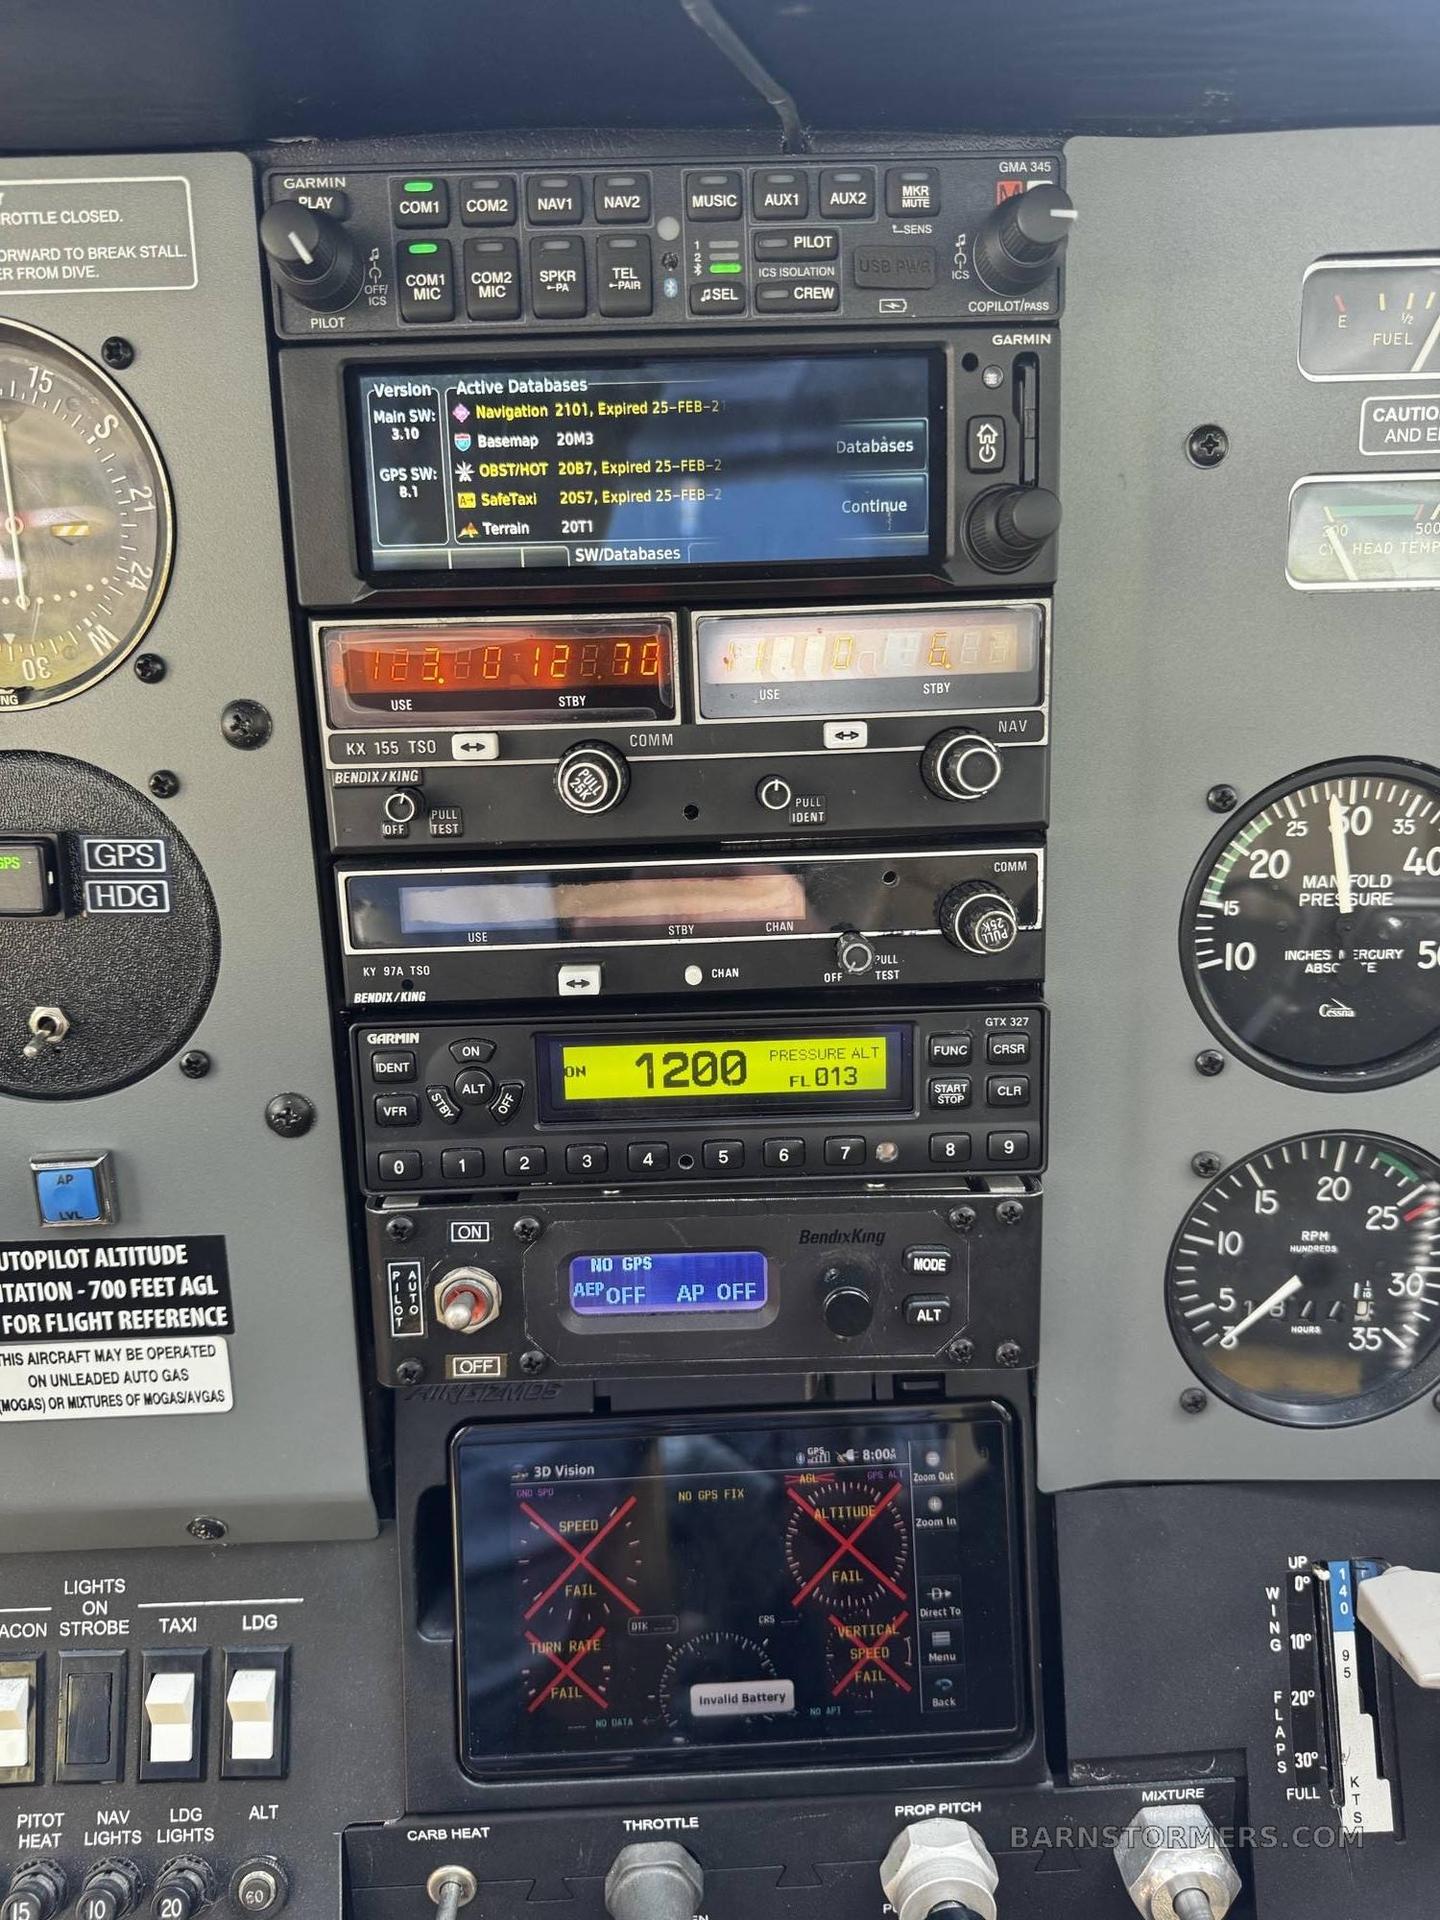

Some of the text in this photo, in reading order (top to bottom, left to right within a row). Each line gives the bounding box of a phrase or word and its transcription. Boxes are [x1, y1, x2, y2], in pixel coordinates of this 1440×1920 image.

[999, 161, 1051, 173] GMA 345
[284, 177, 346, 190] GARMIN
[538, 198, 573, 211] NAV1
[604, 196, 640, 209] NAV2
[692, 195, 737, 208] MUSIC
[765, 194, 798, 206] AUX1
[830, 192, 866, 205] AUX2
[400, 201, 439, 214] COM1
[466, 199, 508, 213] COM2
[61, 210, 123, 224] CLOSED.
[794, 236, 833, 249] PILOT
[67, 245, 187, 260] TO BREAK STALL.
[17, 266, 99, 280] FROM DIVE.
[759, 265, 835, 277] ICS ISOLATION
[794, 287, 834, 300] CREW
[968, 300, 1049, 313] COPILOT/PASS
[311, 318, 345, 329] PILOT
[992, 334, 1051, 346] GARMIN
[1373, 332, 1413, 346] FUEL
[374, 383, 431, 398] Version
[456, 379, 588, 396] Active Databases
[476, 401, 648, 420] Navigation Expired
[391, 428, 419, 441] 3.10
[478, 432, 593, 449] Basemap 20M3
[837, 439, 914, 454] Databases
[479, 460, 651, 477] OBST/HOT Expired
[481, 489, 651, 506] SafeTaxi Expired
[842, 499, 907, 513] Continue
[483, 520, 593, 535] Terrain 20T1
[575, 547, 680, 562] SW/Databases
[391, 700, 412, 711] USE
[559, 695, 586, 707] STBY
[629, 734, 673, 747] COMM
[346, 740, 436, 756] KX 155 TSO
[335, 770, 419, 784] BENDIX/KING
[793, 811, 824, 822] IDENT
[1392, 819, 1415, 835] 35
[95, 844, 155, 867] GPS
[994, 861, 1027, 872] COMM
[1249, 849, 1290, 879] 20
[95, 885, 158, 907] HDG
[669, 925, 694, 935] STBY
[766, 921, 793, 932] CHAN
[468, 932, 488, 942] USE
[1224, 942, 1256, 972] 10
[1284, 950, 1331, 961] INCHES
[363, 965, 430, 976] KY 97A TSO
[354, 991, 426, 1004] BENDIX/KING
[985, 1017, 1029, 1027] GTX 327
[367, 1032, 419, 1045] GARMIN
[462, 1046, 480, 1056] ON
[770, 1047, 879, 1061] PRESSURE ALT
[934, 1045, 967, 1056] FUNC
[993, 1044, 1025, 1055] CRSR
[376, 1062, 410, 1073] IDENT
[635, 1050, 747, 1089] 1200
[815, 1067, 858, 1087] 013
[462, 1083, 485, 1094] ALT
[997, 1086, 1021, 1097] CLR
[383, 1106, 407, 1116] VFR
[1316, 1176, 1350, 1201] 20
[1366, 1206, 1400, 1230] 25
[458, 1226, 482, 1239] ON
[1301, 1231, 1330, 1241] RPM
[1218, 1231, 1243, 1255] 10
[1290, 1244, 1337, 1253] HUNDREDS
[95, 1244, 187, 1268] ALTITUDE
[591, 1256, 652, 1272] NO GPS
[914, 1258, 946, 1271] MODE
[88, 1275, 218, 1299] 700 FEET AGL
[3, 1306, 228, 1335] FOR FLIGHT REFERENCE
[917, 1309, 941, 1322] ALT
[1291, 1326, 1321, 1334] HOURS
[1349, 1327, 1382, 1350] 35
[27, 1345, 216, 1365] AIRCRAFT MAY BE OPERATED
[460, 1361, 493, 1373] OFF
[28, 1369, 189, 1387] ON UNLEADED AUTO GAS
[50, 1390, 225, 1410] OR MIXTURES OF MOGAS/AVGAS
[534, 1464, 595, 1477] 3D Vision
[913, 1471, 954, 1482] Zoom Out
[678, 1488, 746, 1501] NO GPS FIX
[814, 1505, 876, 1520] ALTITUDE
[559, 1519, 599, 1533] SPEED
[916, 1518, 942, 1527] Zoom
[1288, 1556, 1307, 1568] UP
[832, 1570, 863, 1582] FAIL
[64, 1579, 126, 1594] LIGHTS
[565, 1584, 596, 1596] FAIL
[82, 1601, 108, 1616] ON
[920, 1607, 961, 1617] Direct To
[59, 1620, 130, 1636] STROBE
[159, 1617, 197, 1633] TAXI
[242, 1614, 278, 1630] LDG
[530, 1639, 601, 1654] TURN RATE
[929, 1652, 956, 1662] Menu
[700, 1693, 785, 1705] Invalid Battery
[933, 1698, 956, 1707] Back
[1142, 1788, 1204, 1801] MIXTURE
[1286, 1788, 1320, 1800] FULL
[170, 1808, 202, 1822] LDG
[249, 1805, 279, 1820] ALT
[895, 1802, 981, 1817] PROP PITCH
[17, 1813, 65, 1828] PITOT
[97, 1810, 130, 1824] NAV
[623, 1817, 699, 1831] THROTTLE
[18, 1833, 62, 1848] HEAT
[84, 1830, 142, 1846] LIGHTS
[157, 1828, 214, 1843] LIGHTS
[407, 1827, 490, 1841] CARB HEAT
